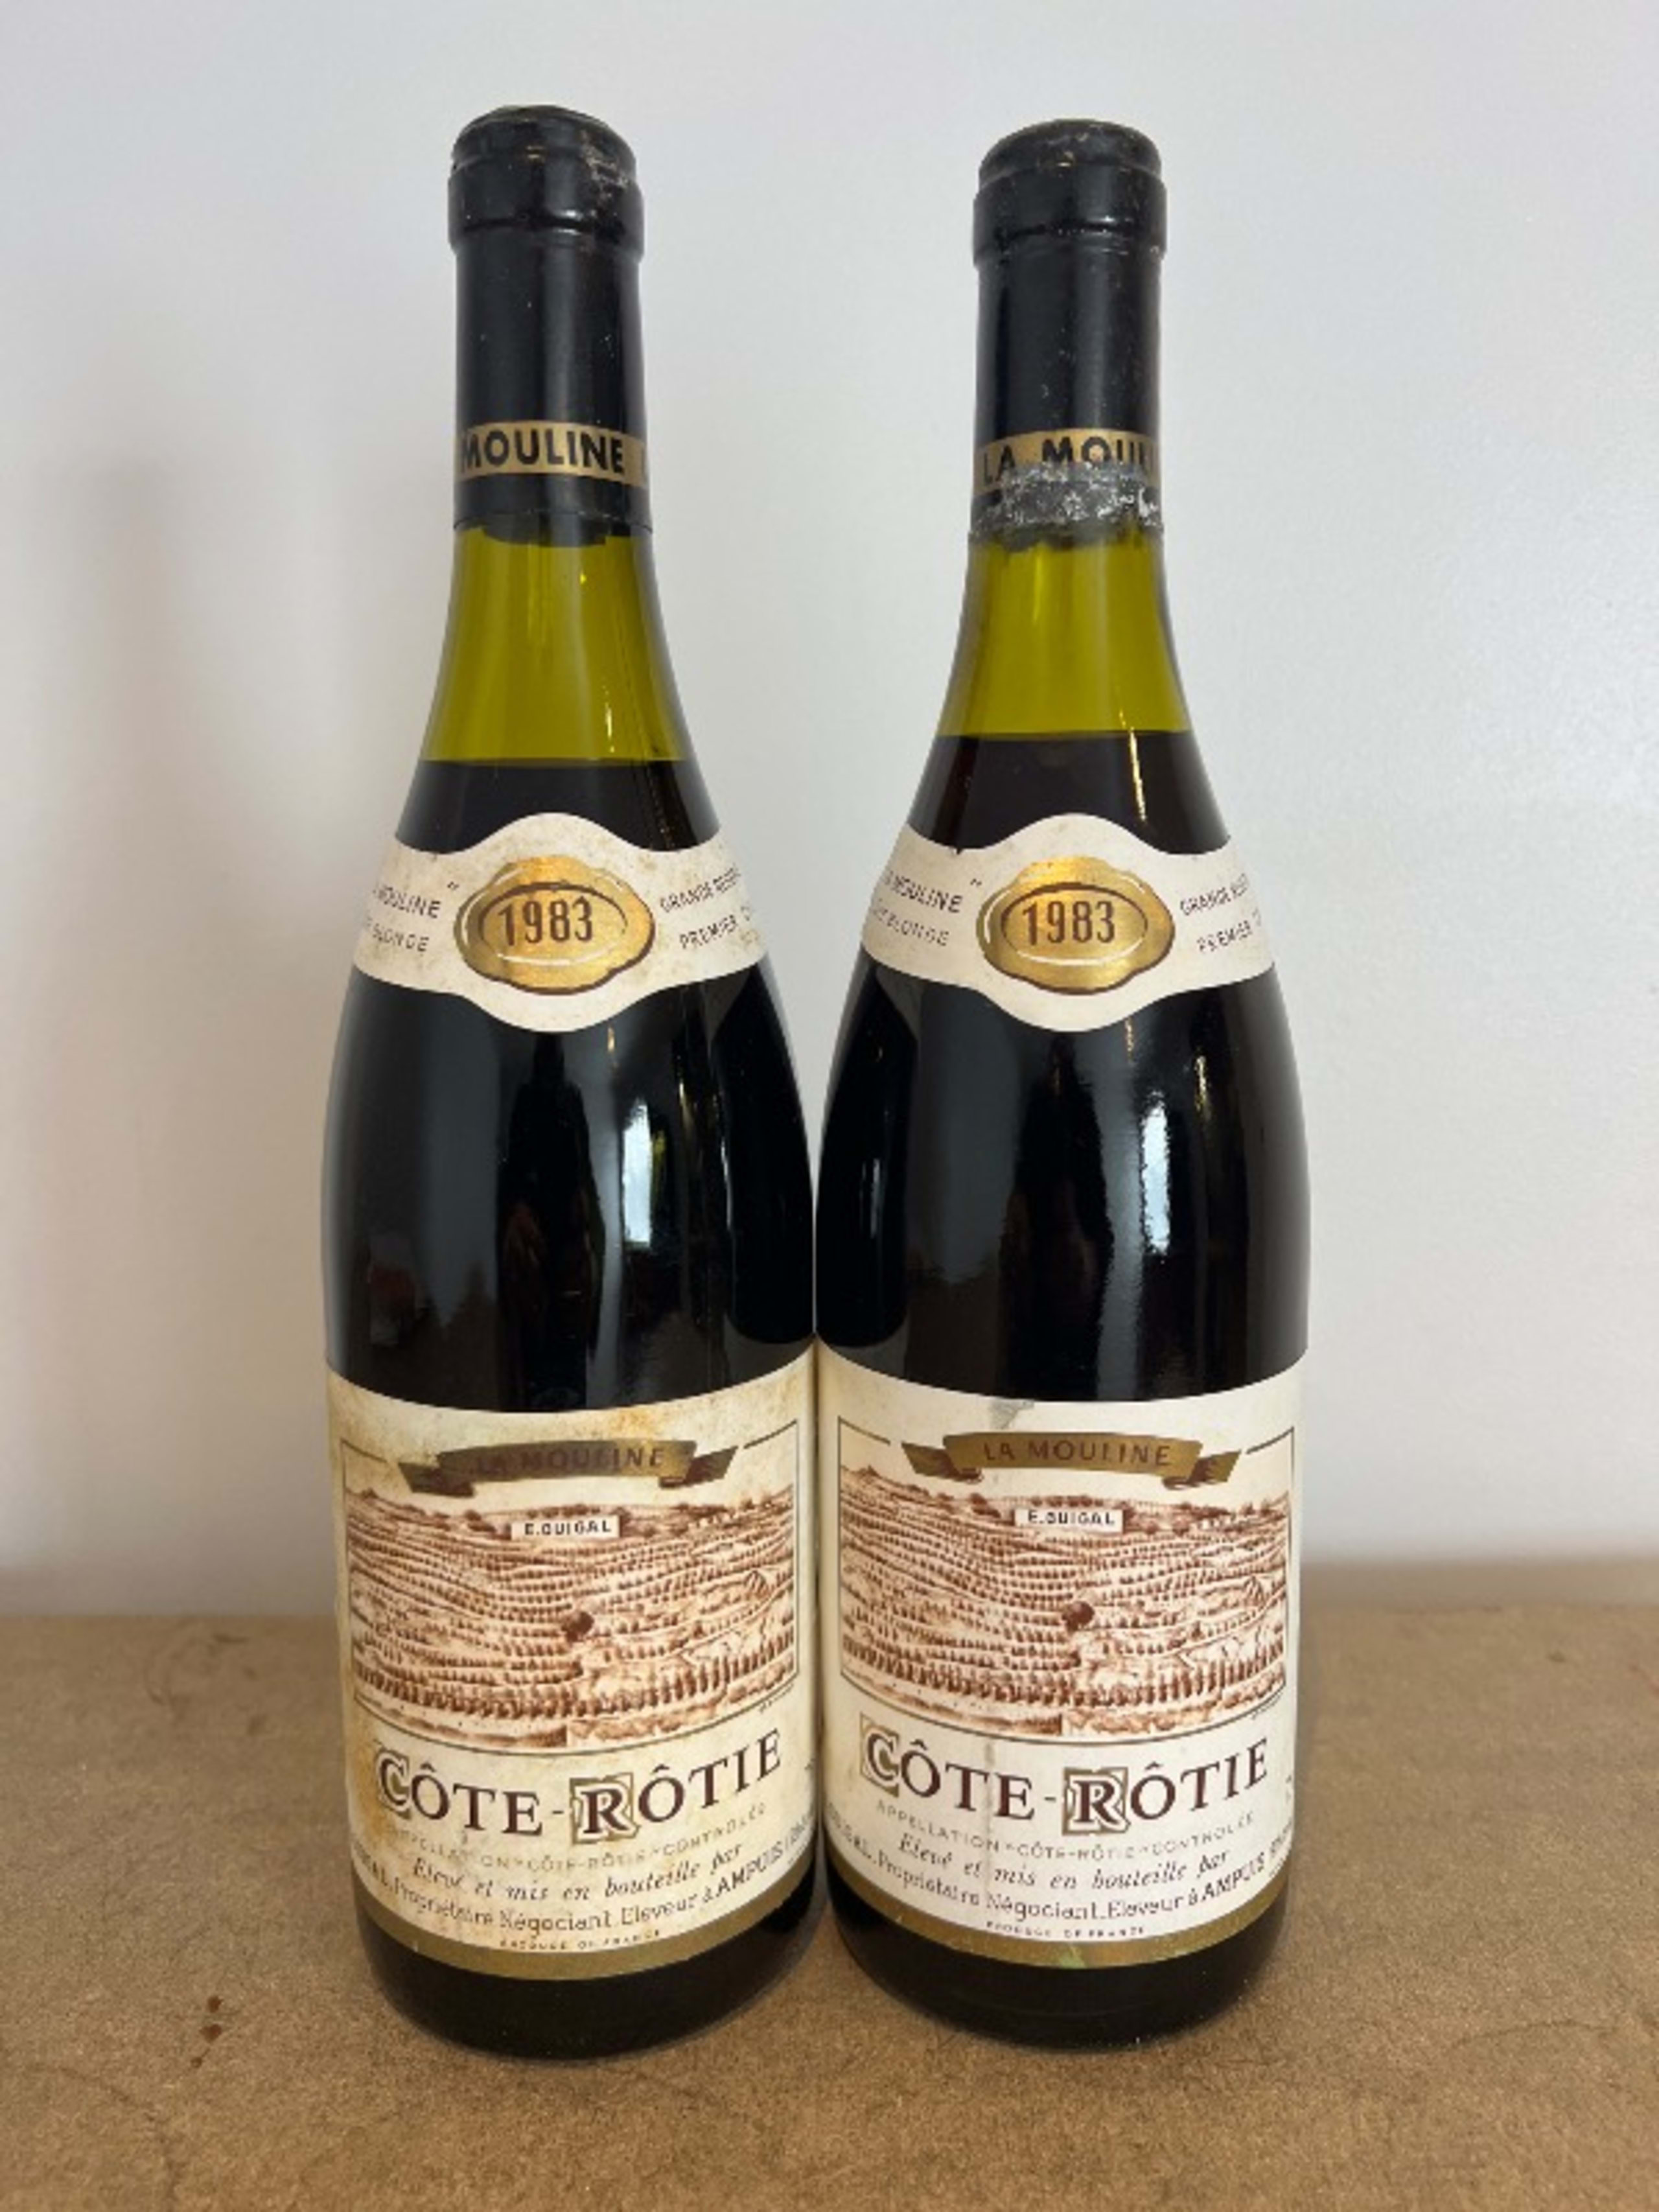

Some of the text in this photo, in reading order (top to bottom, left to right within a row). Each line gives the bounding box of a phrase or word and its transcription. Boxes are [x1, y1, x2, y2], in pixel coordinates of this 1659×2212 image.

[498, 895, 593, 947] 1983
[1023, 899, 1115, 946] 1983
[525, 1447, 666, 1473] MOULINE
[983, 1439, 1172, 1467] LA MOULINE
[877, 1799, 999, 1854] APPELLATION
[507, 1880, 548, 1901] mis
[563, 1885, 590, 1900] en
[604, 1859, 701, 1898] bouteille
[994, 1865, 1035, 1886] mis
[1049, 1876, 1077, 1889] en
[1091, 1859, 1187, 1891] bouteille
